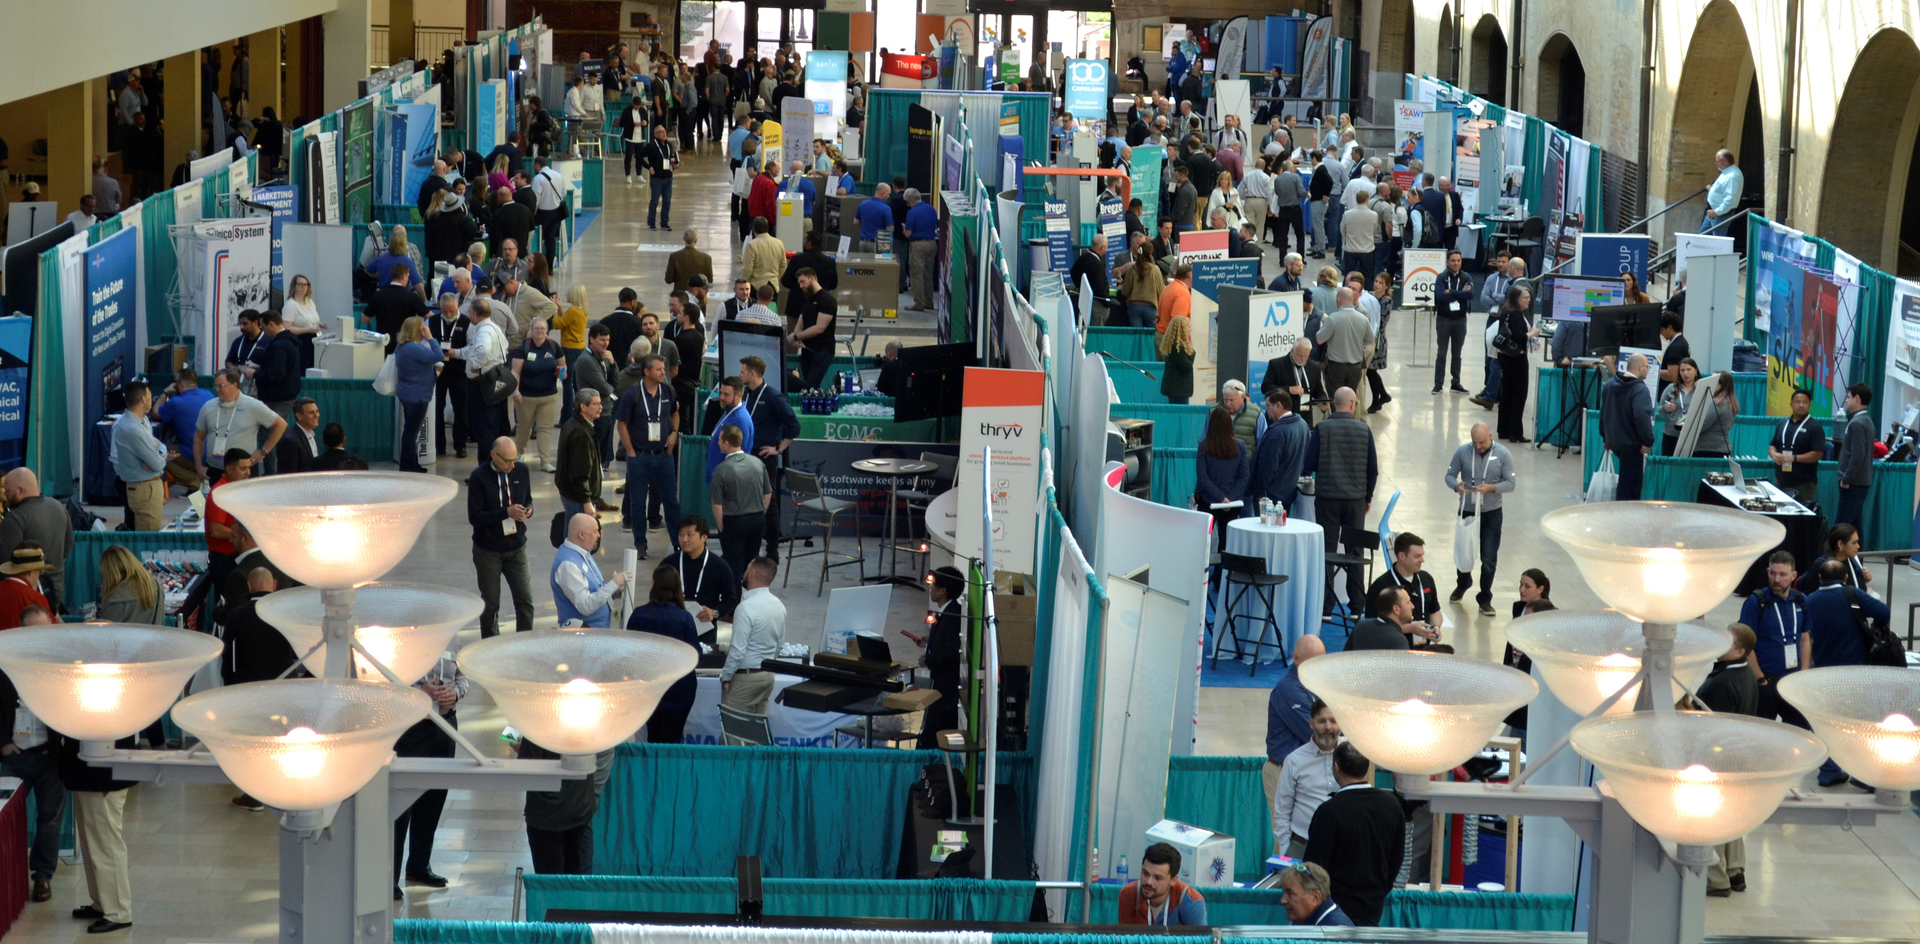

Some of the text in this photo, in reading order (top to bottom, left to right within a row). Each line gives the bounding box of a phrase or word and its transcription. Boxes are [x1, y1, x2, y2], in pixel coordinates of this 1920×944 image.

[896, 60, 922, 70] The new
[1069, 62, 1106, 82] 100
[1403, 110, 1424, 118] SAWI
[481, 109, 492, 152] AERO
[257, 190, 293, 201] MARKETING
[1045, 202, 1067, 215] Breeze
[1100, 203, 1123, 215] Breeze
[235, 228, 264, 240] System
[853, 268, 875, 276] YORK
[92, 287, 102, 306] Train
[110, 278, 124, 296] Future
[1411, 283, 1436, 293] 400
[104, 300, 118, 320] Trades
[1258, 332, 1296, 348] Aletheia
[1261, 347, 1292, 355] DIGITA
[0, 382, 20, 393] VAC,
[0, 398, 20, 407] nical
[0, 411, 20, 421] rical
[980, 423, 1023, 440] thryv
[419, 444, 427, 458] The
[831, 475, 874, 484] software
[920, 478, 936, 488] my
